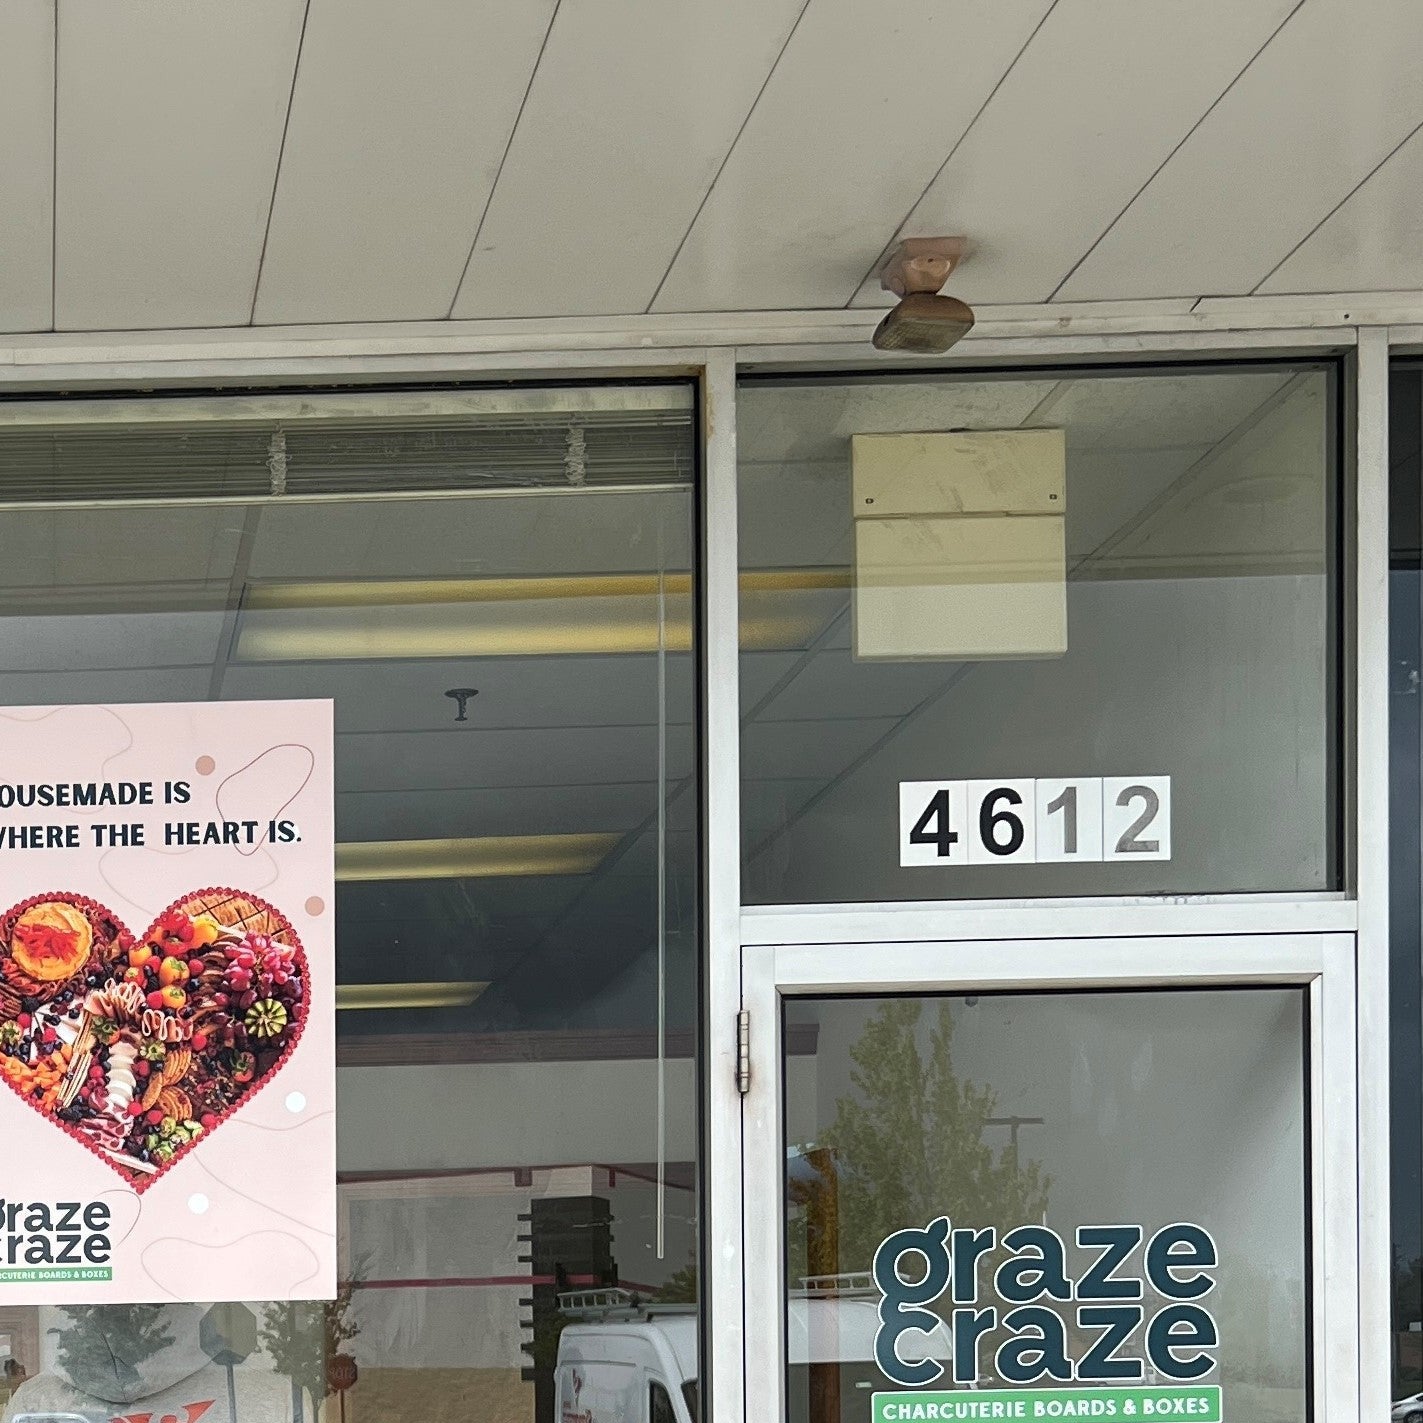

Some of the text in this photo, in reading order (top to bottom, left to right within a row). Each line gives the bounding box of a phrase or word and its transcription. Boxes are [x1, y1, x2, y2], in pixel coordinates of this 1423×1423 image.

[164, 781, 191, 804] IS
[91, 823, 145, 847] THE
[164, 821, 259, 845] HEART
[268, 820, 302, 843] IS.
[909, 785, 1160, 857] 4612
[873, 1215, 1218, 1306] graze
[38, 1271, 72, 1279] BOARDS
[73, 1271, 80, 1279] &
[81, 1270, 108, 1279] BOXES
[873, 1304, 1219, 1387] craze
[882, 1397, 1210, 1421] CHARCUTERIE BOARDS & BOXES
